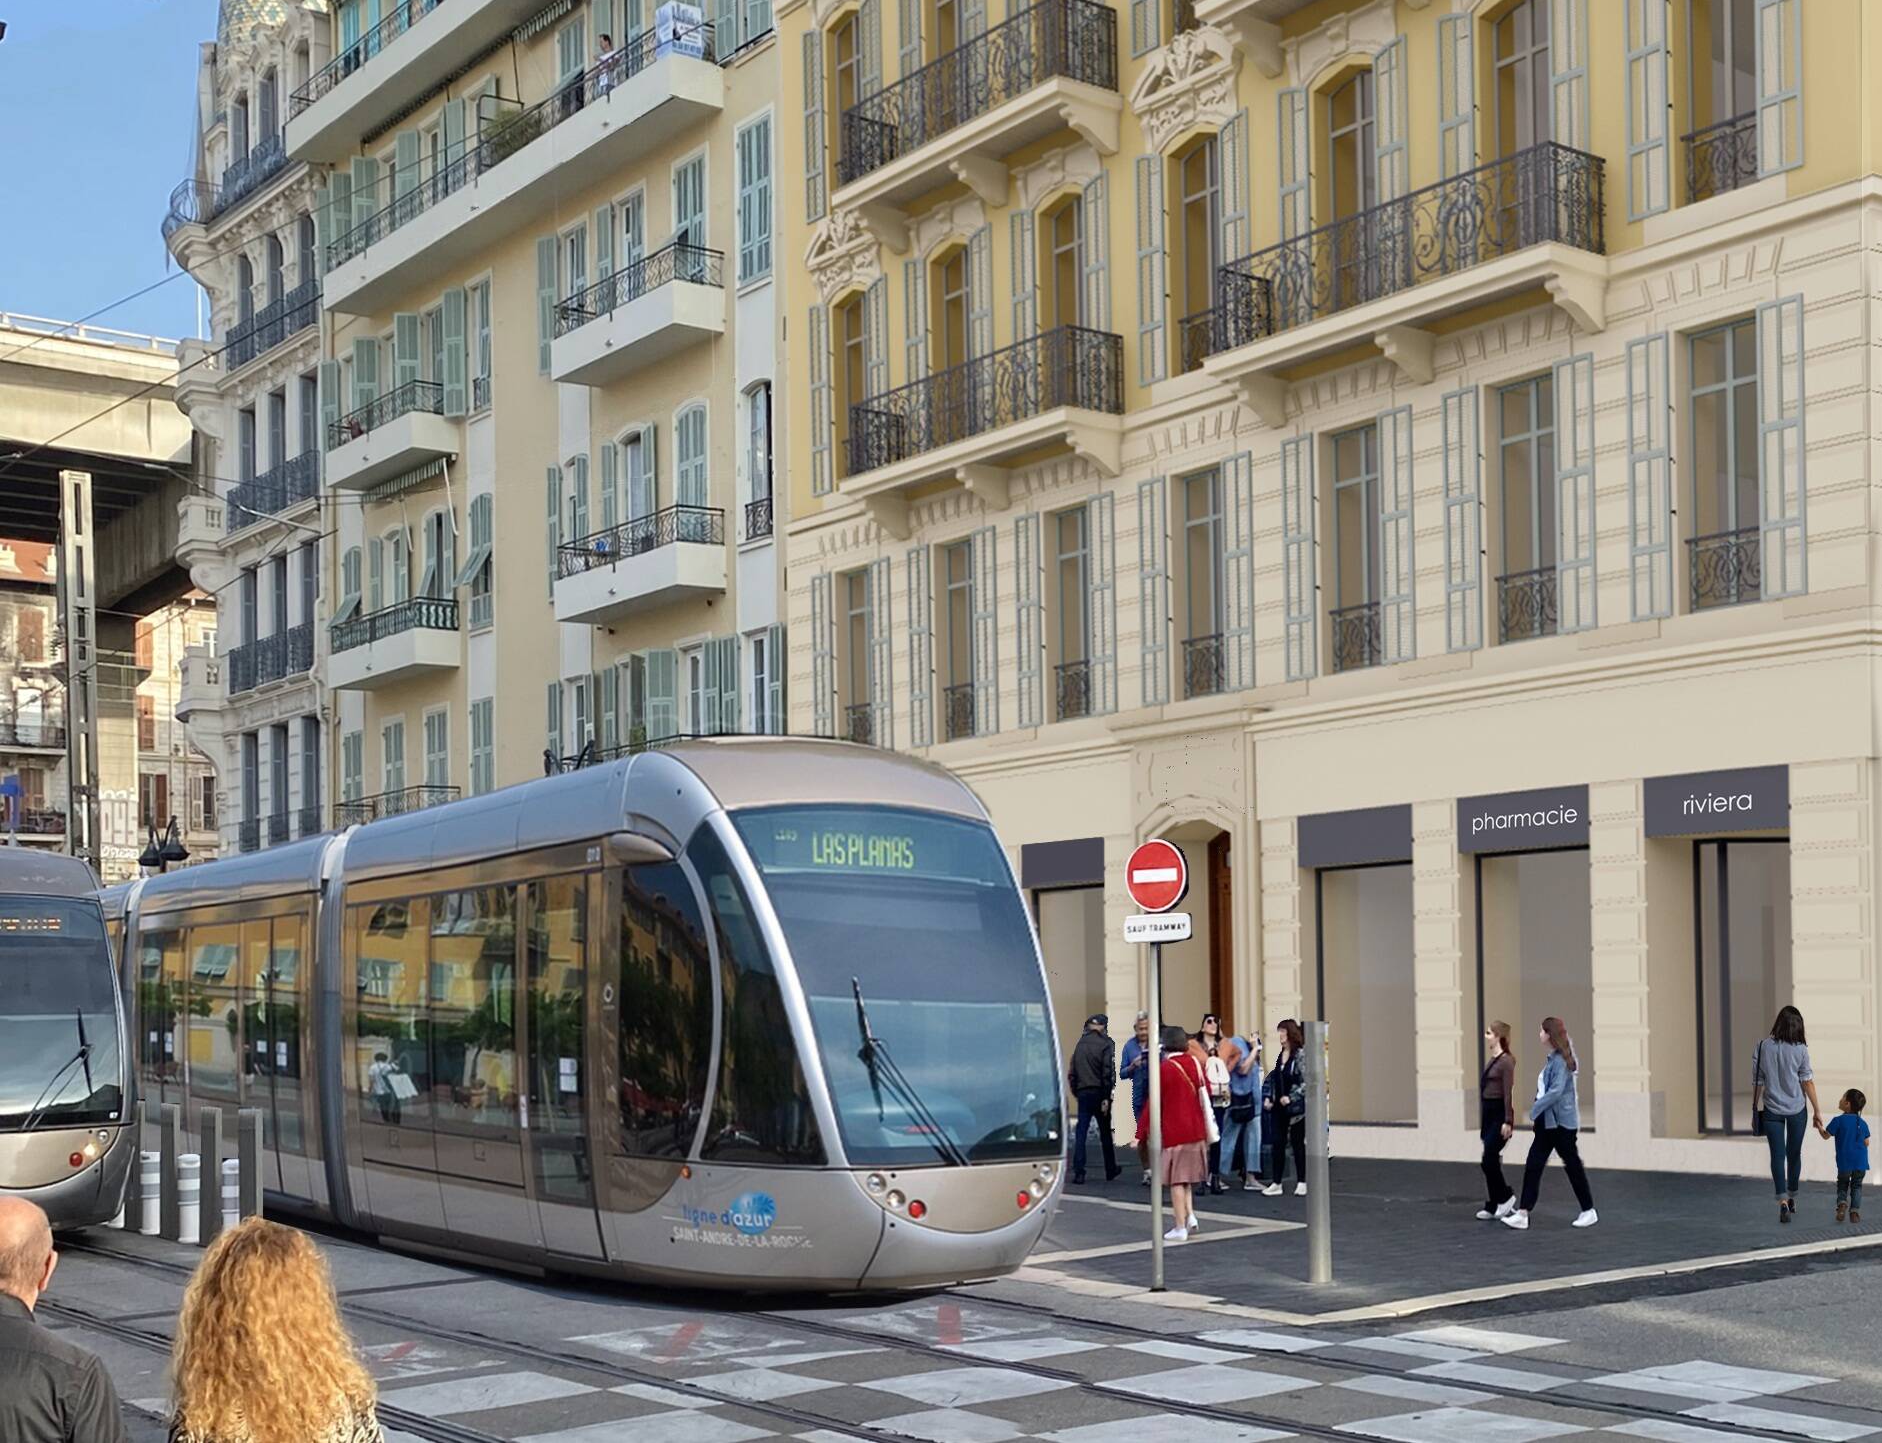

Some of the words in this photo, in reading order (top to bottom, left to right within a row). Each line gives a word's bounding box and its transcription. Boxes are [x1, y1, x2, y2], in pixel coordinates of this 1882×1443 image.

[1682, 792, 1753, 815] riviera
[1471, 804, 1578, 835] pharmacie
[1127, 924, 1147, 934] SAUF
[1149, 923, 1186, 932] TRAMWAY
[682, 1203, 717, 1227] ligne
